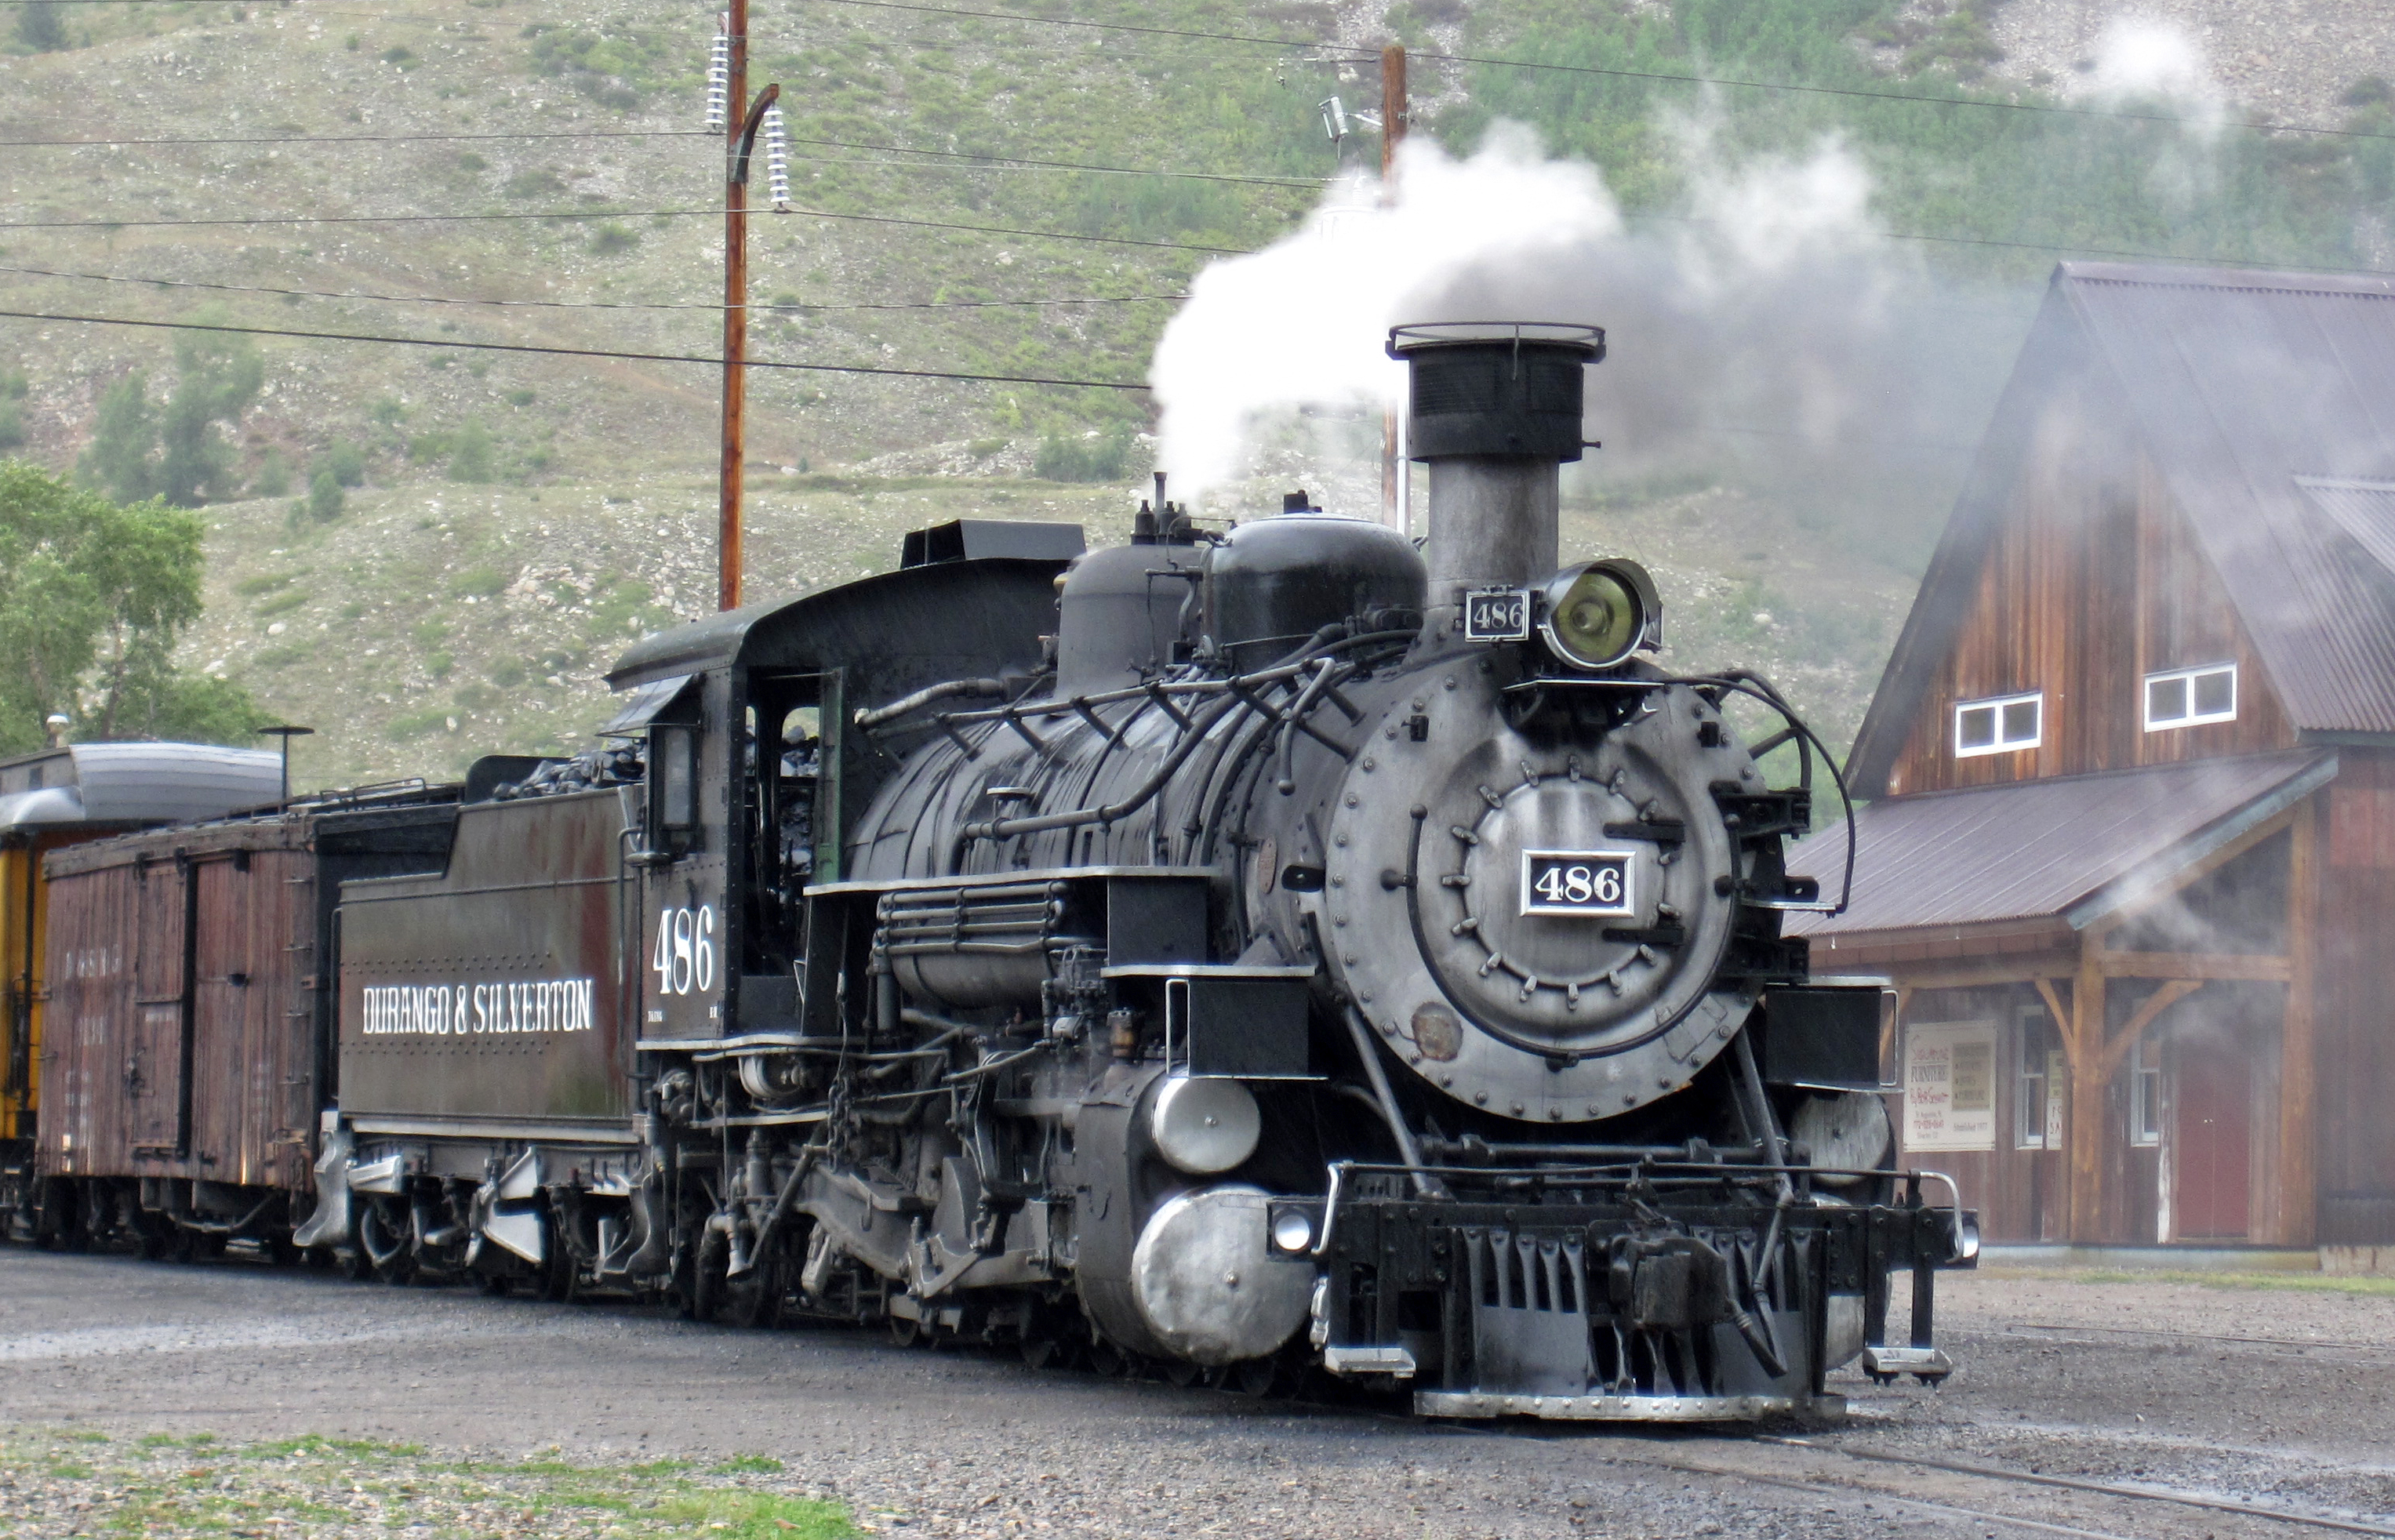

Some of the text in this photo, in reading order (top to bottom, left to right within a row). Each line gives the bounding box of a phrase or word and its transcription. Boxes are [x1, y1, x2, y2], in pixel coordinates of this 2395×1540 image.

[1474, 602, 1523, 629] 486
[1535, 866, 1620, 903] 486
[652, 905, 712, 995] 486
[362, 979, 591, 1035] DURANGO & SILVERTON
[1911, 1065, 1947, 1082] FURNITURE
